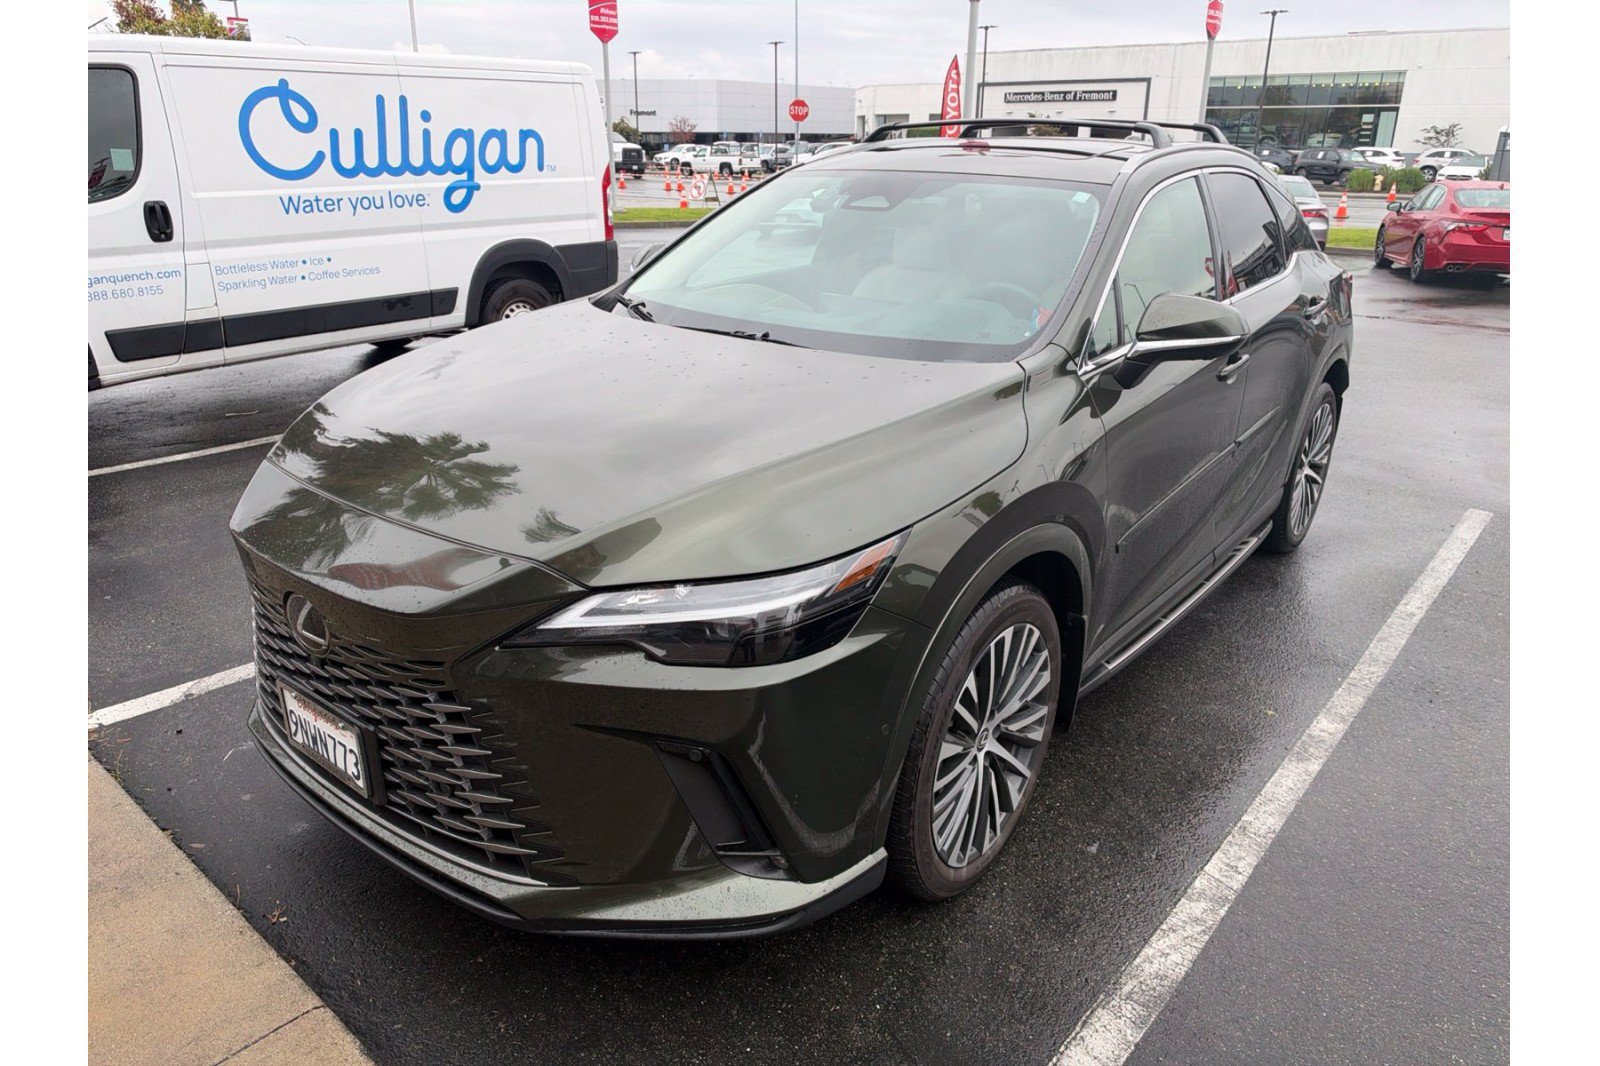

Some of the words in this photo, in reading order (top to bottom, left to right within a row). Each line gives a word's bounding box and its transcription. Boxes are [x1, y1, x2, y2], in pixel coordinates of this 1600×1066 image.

[945, 69, 959, 138] OYOTA
[1006, 91, 1064, 102] Mercedes-Benz
[1066, 91, 1075, 101] of
[1077, 91, 1113, 100] Fremont
[790, 105, 808, 116] STOP
[238, 78, 545, 214] Culligan
[546, 164, 557, 173] TM
[279, 195, 344, 215] Water
[348, 195, 384, 216] you
[214, 261, 268, 276] Bottleless
[269, 259, 300, 270] Water
[309, 256, 324, 266] Ice
[217, 277, 267, 293] Sparkling
[268, 274, 298, 285] Water
[308, 269, 340, 281] Coffee
[341, 265, 381, 278] Services
[288, 709, 361, 781] 9NWN773
